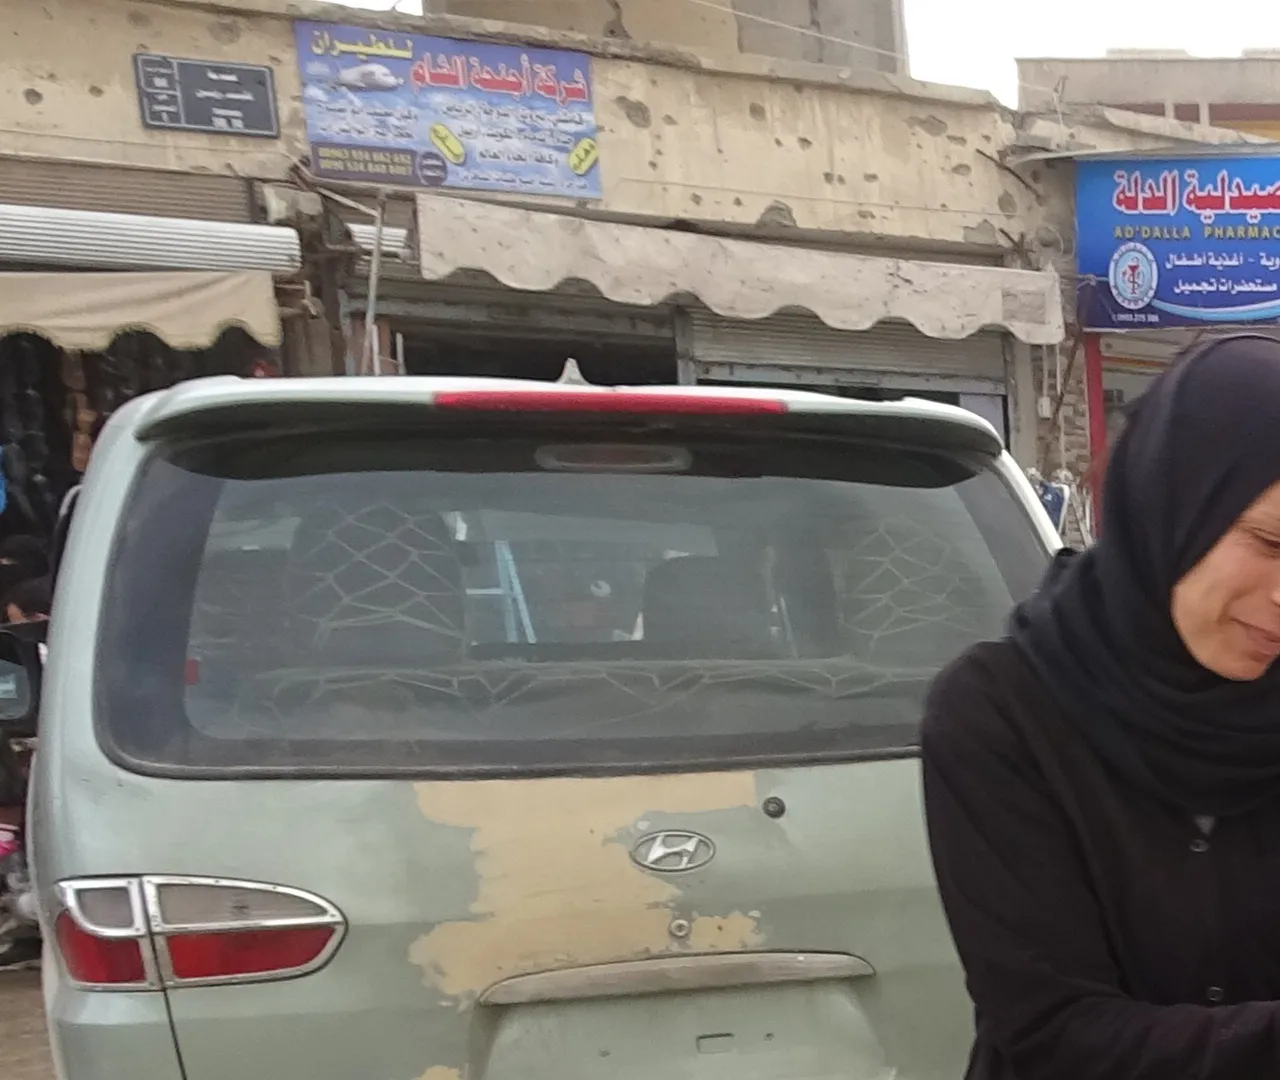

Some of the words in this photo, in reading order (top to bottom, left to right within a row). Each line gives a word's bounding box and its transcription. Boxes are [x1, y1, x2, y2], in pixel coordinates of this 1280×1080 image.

[311, 30, 413, 60] للطيران
[410, 51, 468, 97] الشام
[533, 63, 589, 106] شركة
[1112, 168, 1180, 216] الدلة
[1113, 224, 1191, 239] AD'DALLA
[1207, 251, 1244, 270] أغذية
[1173, 278, 1217, 295] تجميل
[1218, 278, 1278, 295] مستحضرات
